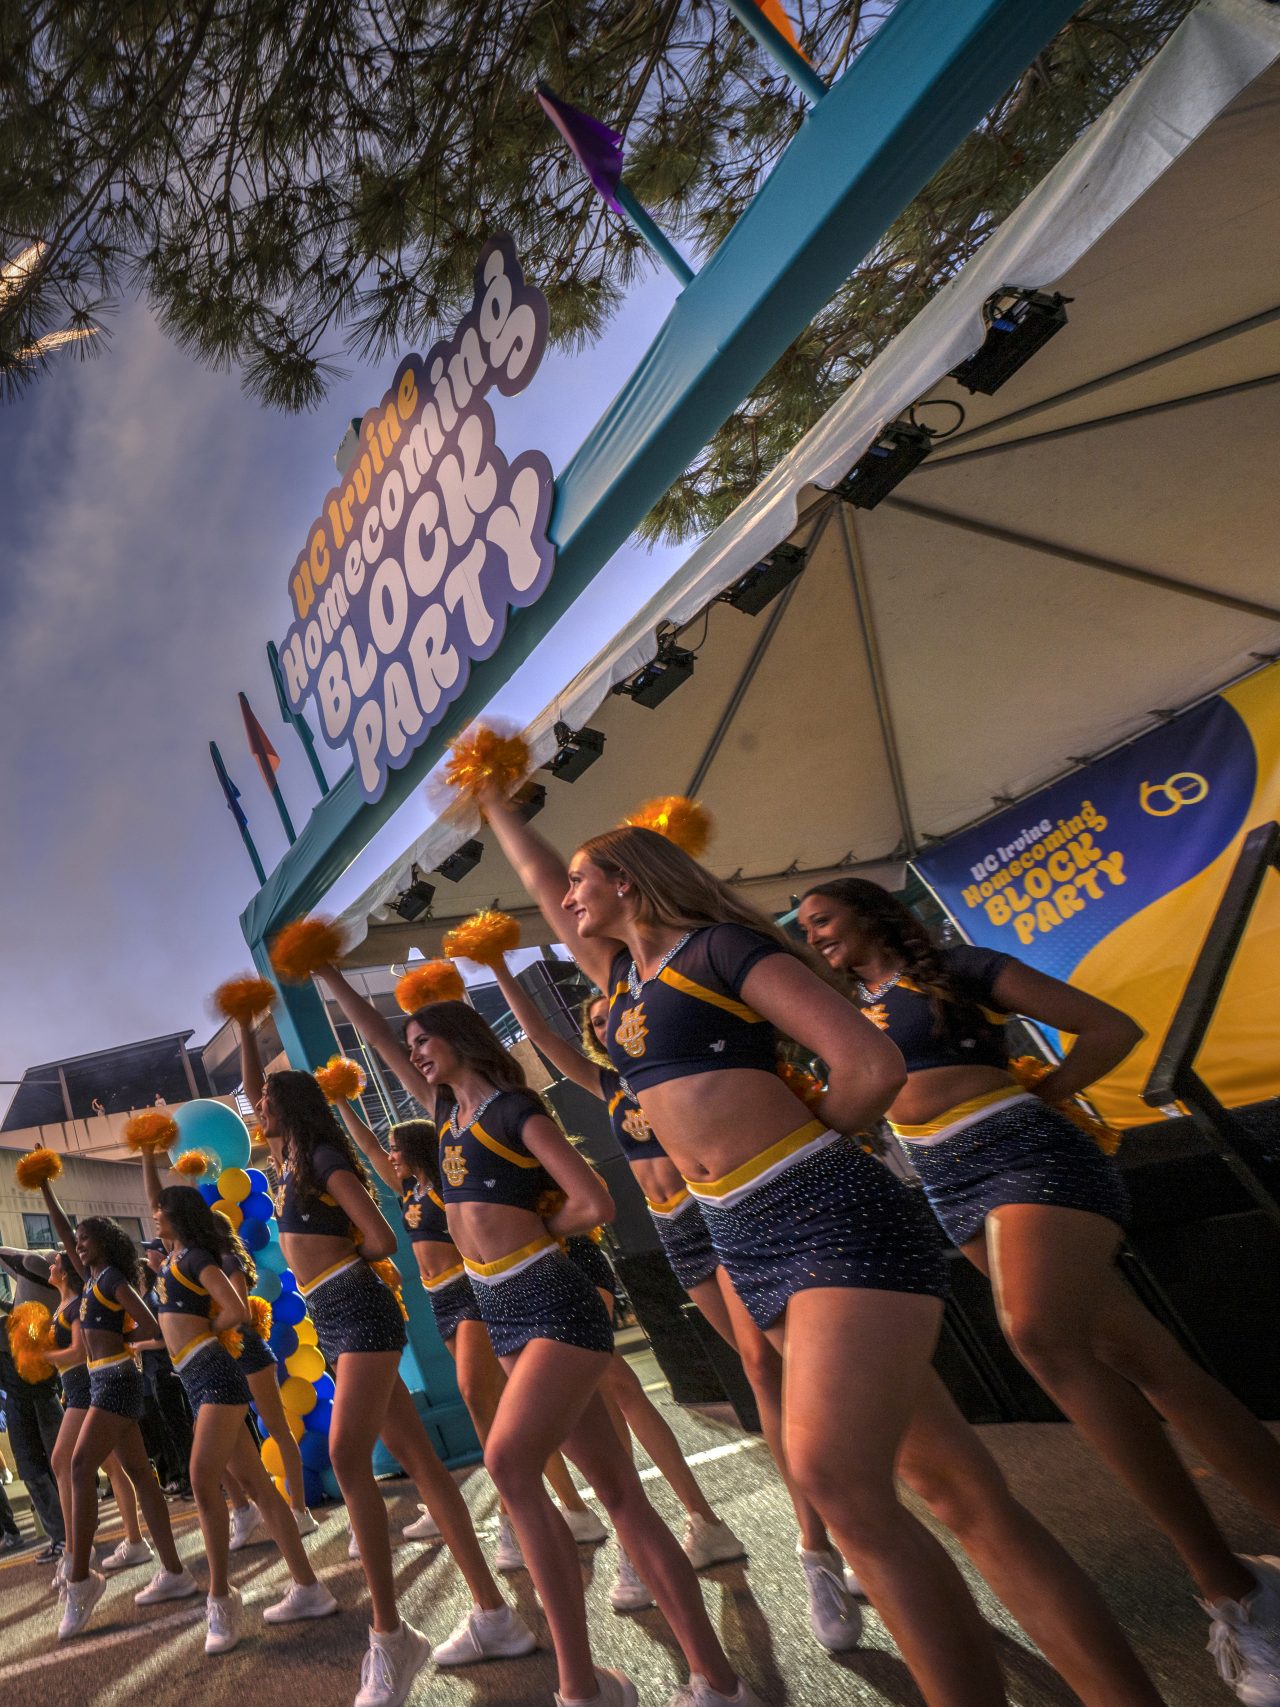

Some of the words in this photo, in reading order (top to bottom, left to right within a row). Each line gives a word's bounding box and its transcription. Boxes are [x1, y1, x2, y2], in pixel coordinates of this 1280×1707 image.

[282, 249, 536, 703] Homecoming
[328, 368, 418, 550] Irvine
[317, 413, 498, 739] BLOCK
[353, 466, 543, 792] PARTY
[961, 800, 1108, 908] Homecoming
[984, 832, 1102, 926] BLOCK
[996, 818, 1053, 862] Irvine
[1013, 851, 1127, 944] PARTY
